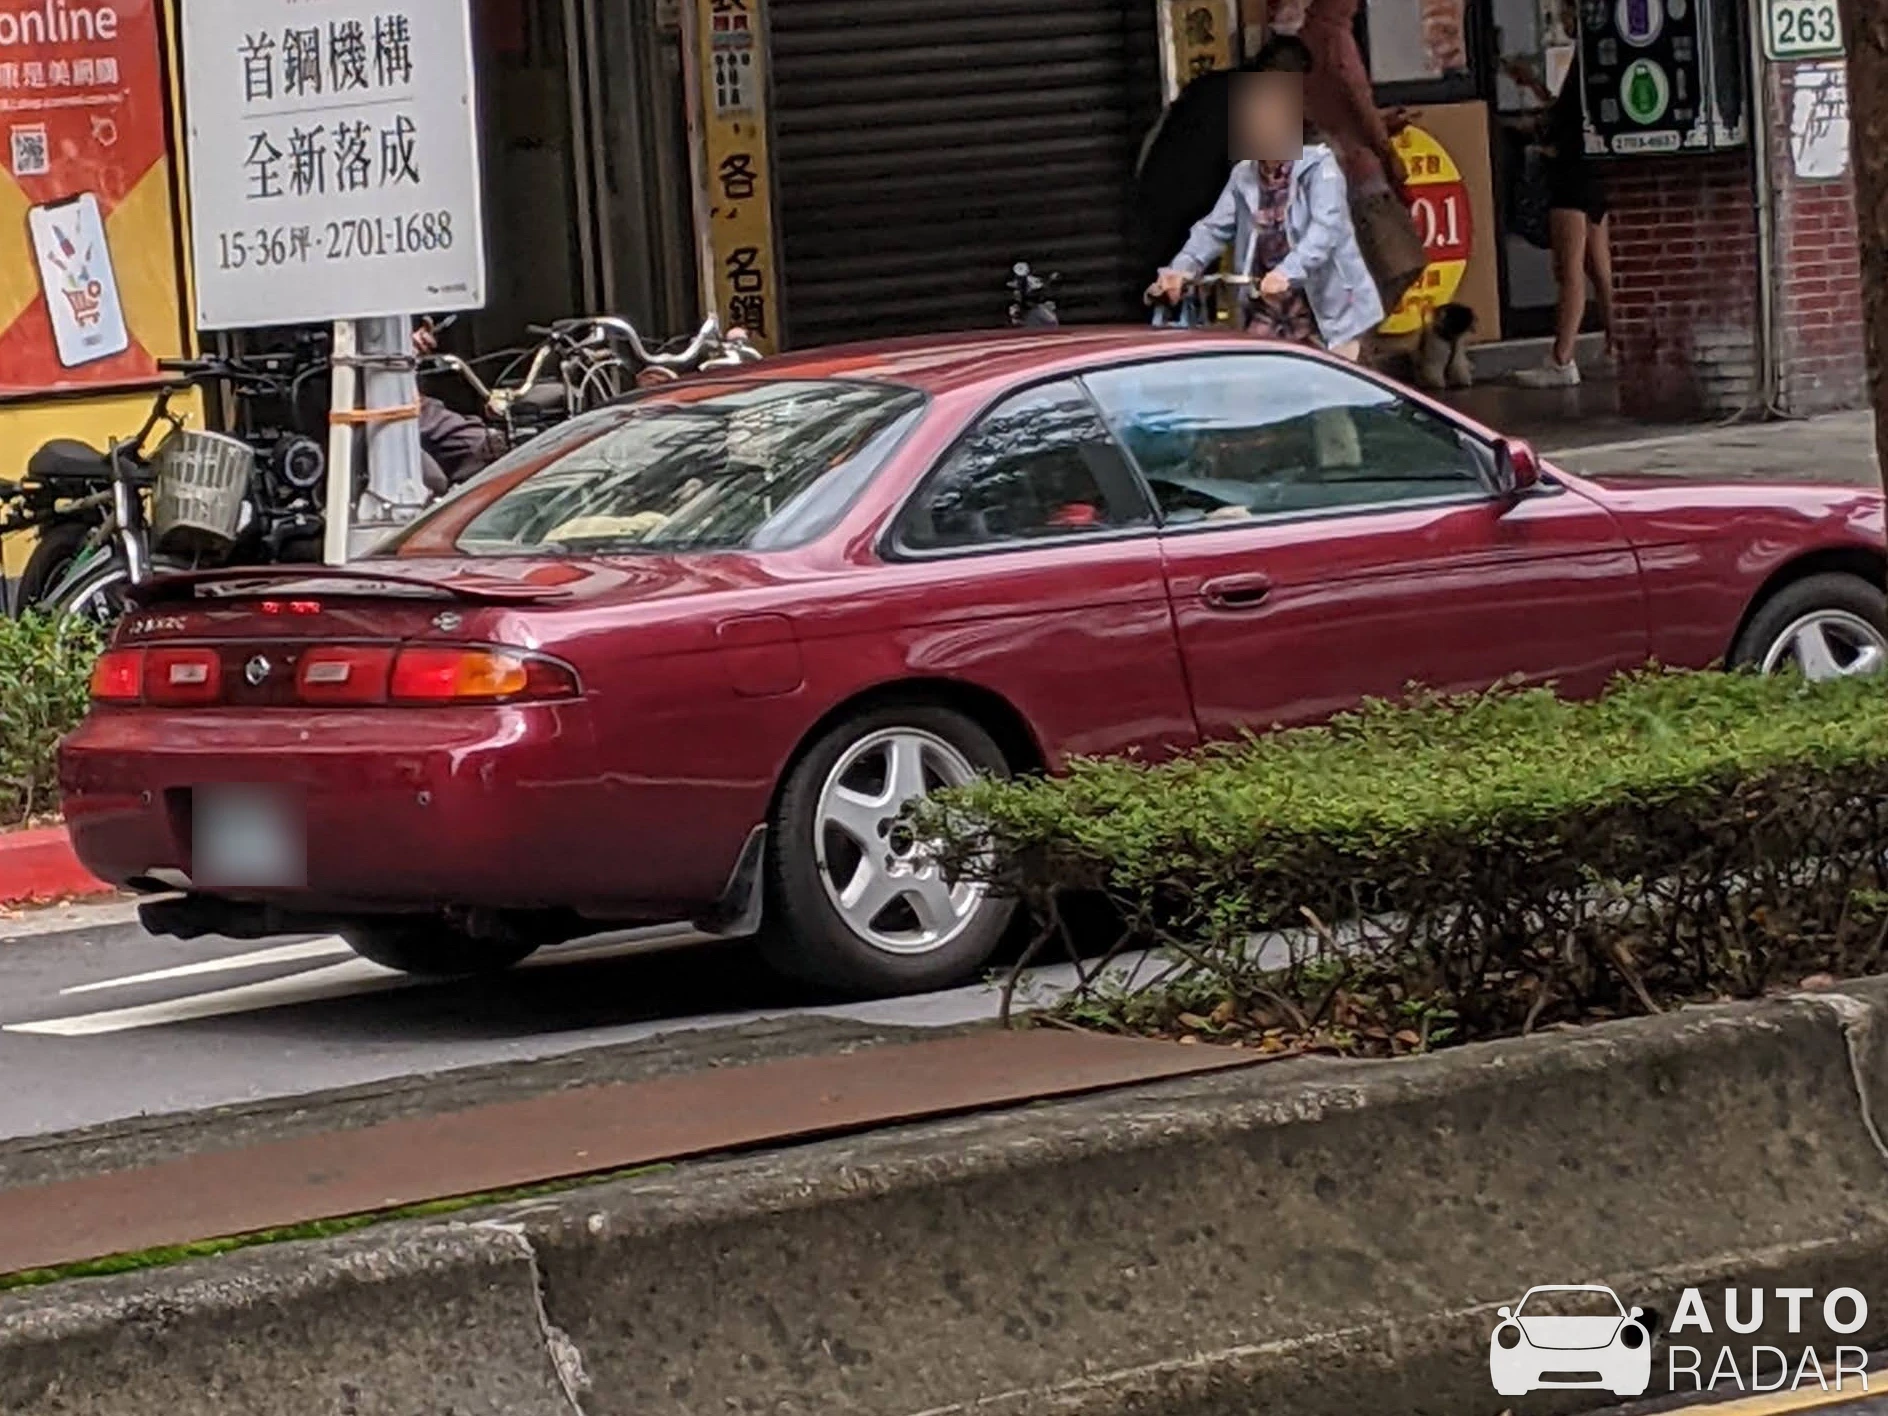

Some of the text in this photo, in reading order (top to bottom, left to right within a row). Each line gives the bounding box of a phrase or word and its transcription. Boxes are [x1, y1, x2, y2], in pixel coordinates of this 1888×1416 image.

[0, 0, 117, 45] online
[1777, 6, 1835, 44] 263
[237, 14, 413, 102] 首鋼機構
[243, 114, 421, 199] 全新落成
